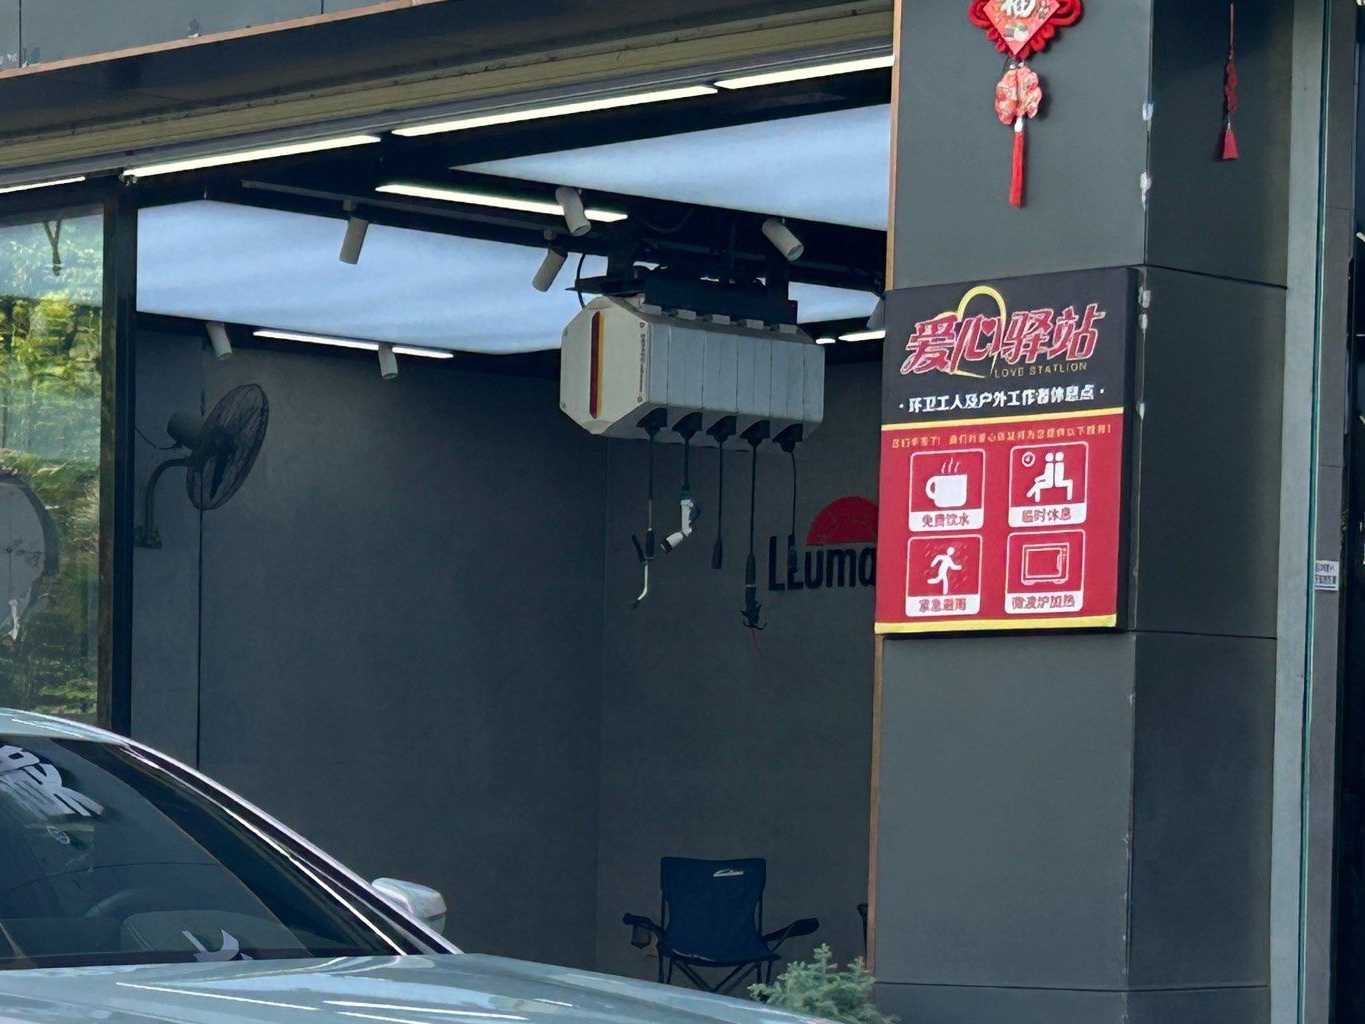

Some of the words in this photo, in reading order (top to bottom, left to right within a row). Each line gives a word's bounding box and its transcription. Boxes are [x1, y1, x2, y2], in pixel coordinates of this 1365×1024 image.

[900, 303, 1106, 375] 爱心驿站
[995, 367, 1024, 379] LOVE
[922, 513, 970, 528] 免费饮水
[1022, 507, 1072, 523] 临时休息
